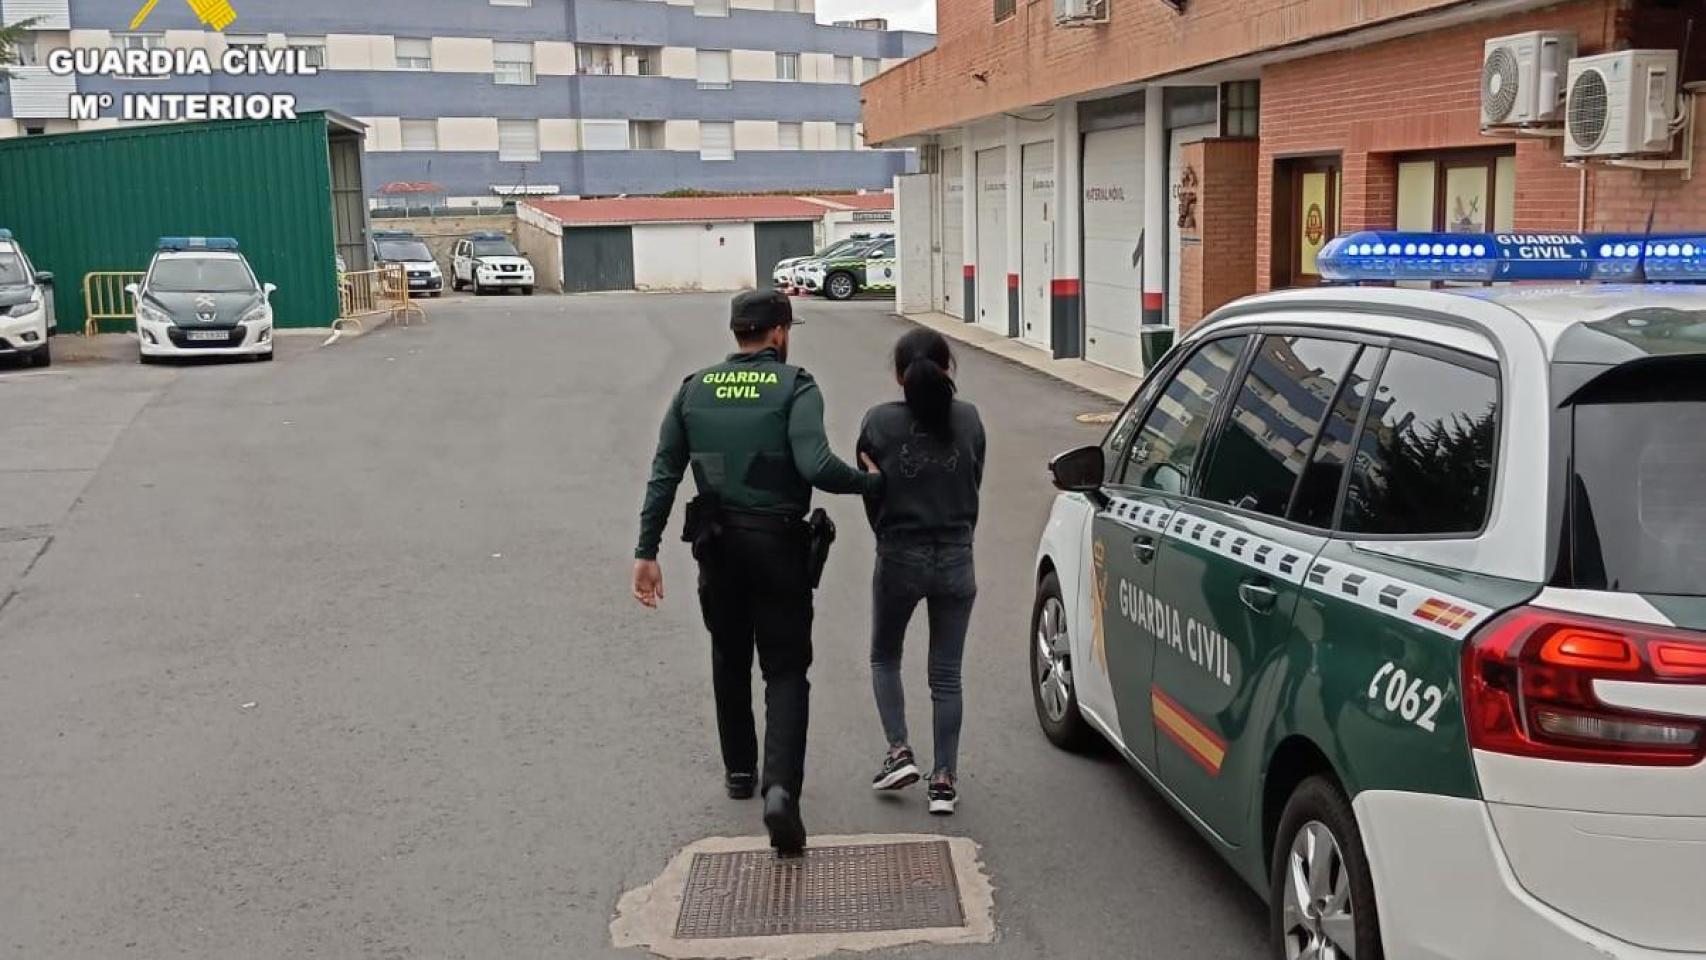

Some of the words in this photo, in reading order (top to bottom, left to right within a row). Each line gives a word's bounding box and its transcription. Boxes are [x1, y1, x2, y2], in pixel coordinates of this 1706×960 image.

[1496, 234, 1585, 245] GUARDIA
[1518, 245, 1573, 259] CIVIL
[702, 371, 778, 384] GUARDIA
[715, 385, 761, 399] CIVIL
[1119, 578, 1184, 654] GUARDIA
[1186, 617, 1232, 687] CIVIL
[1385, 668, 1442, 733] 062
